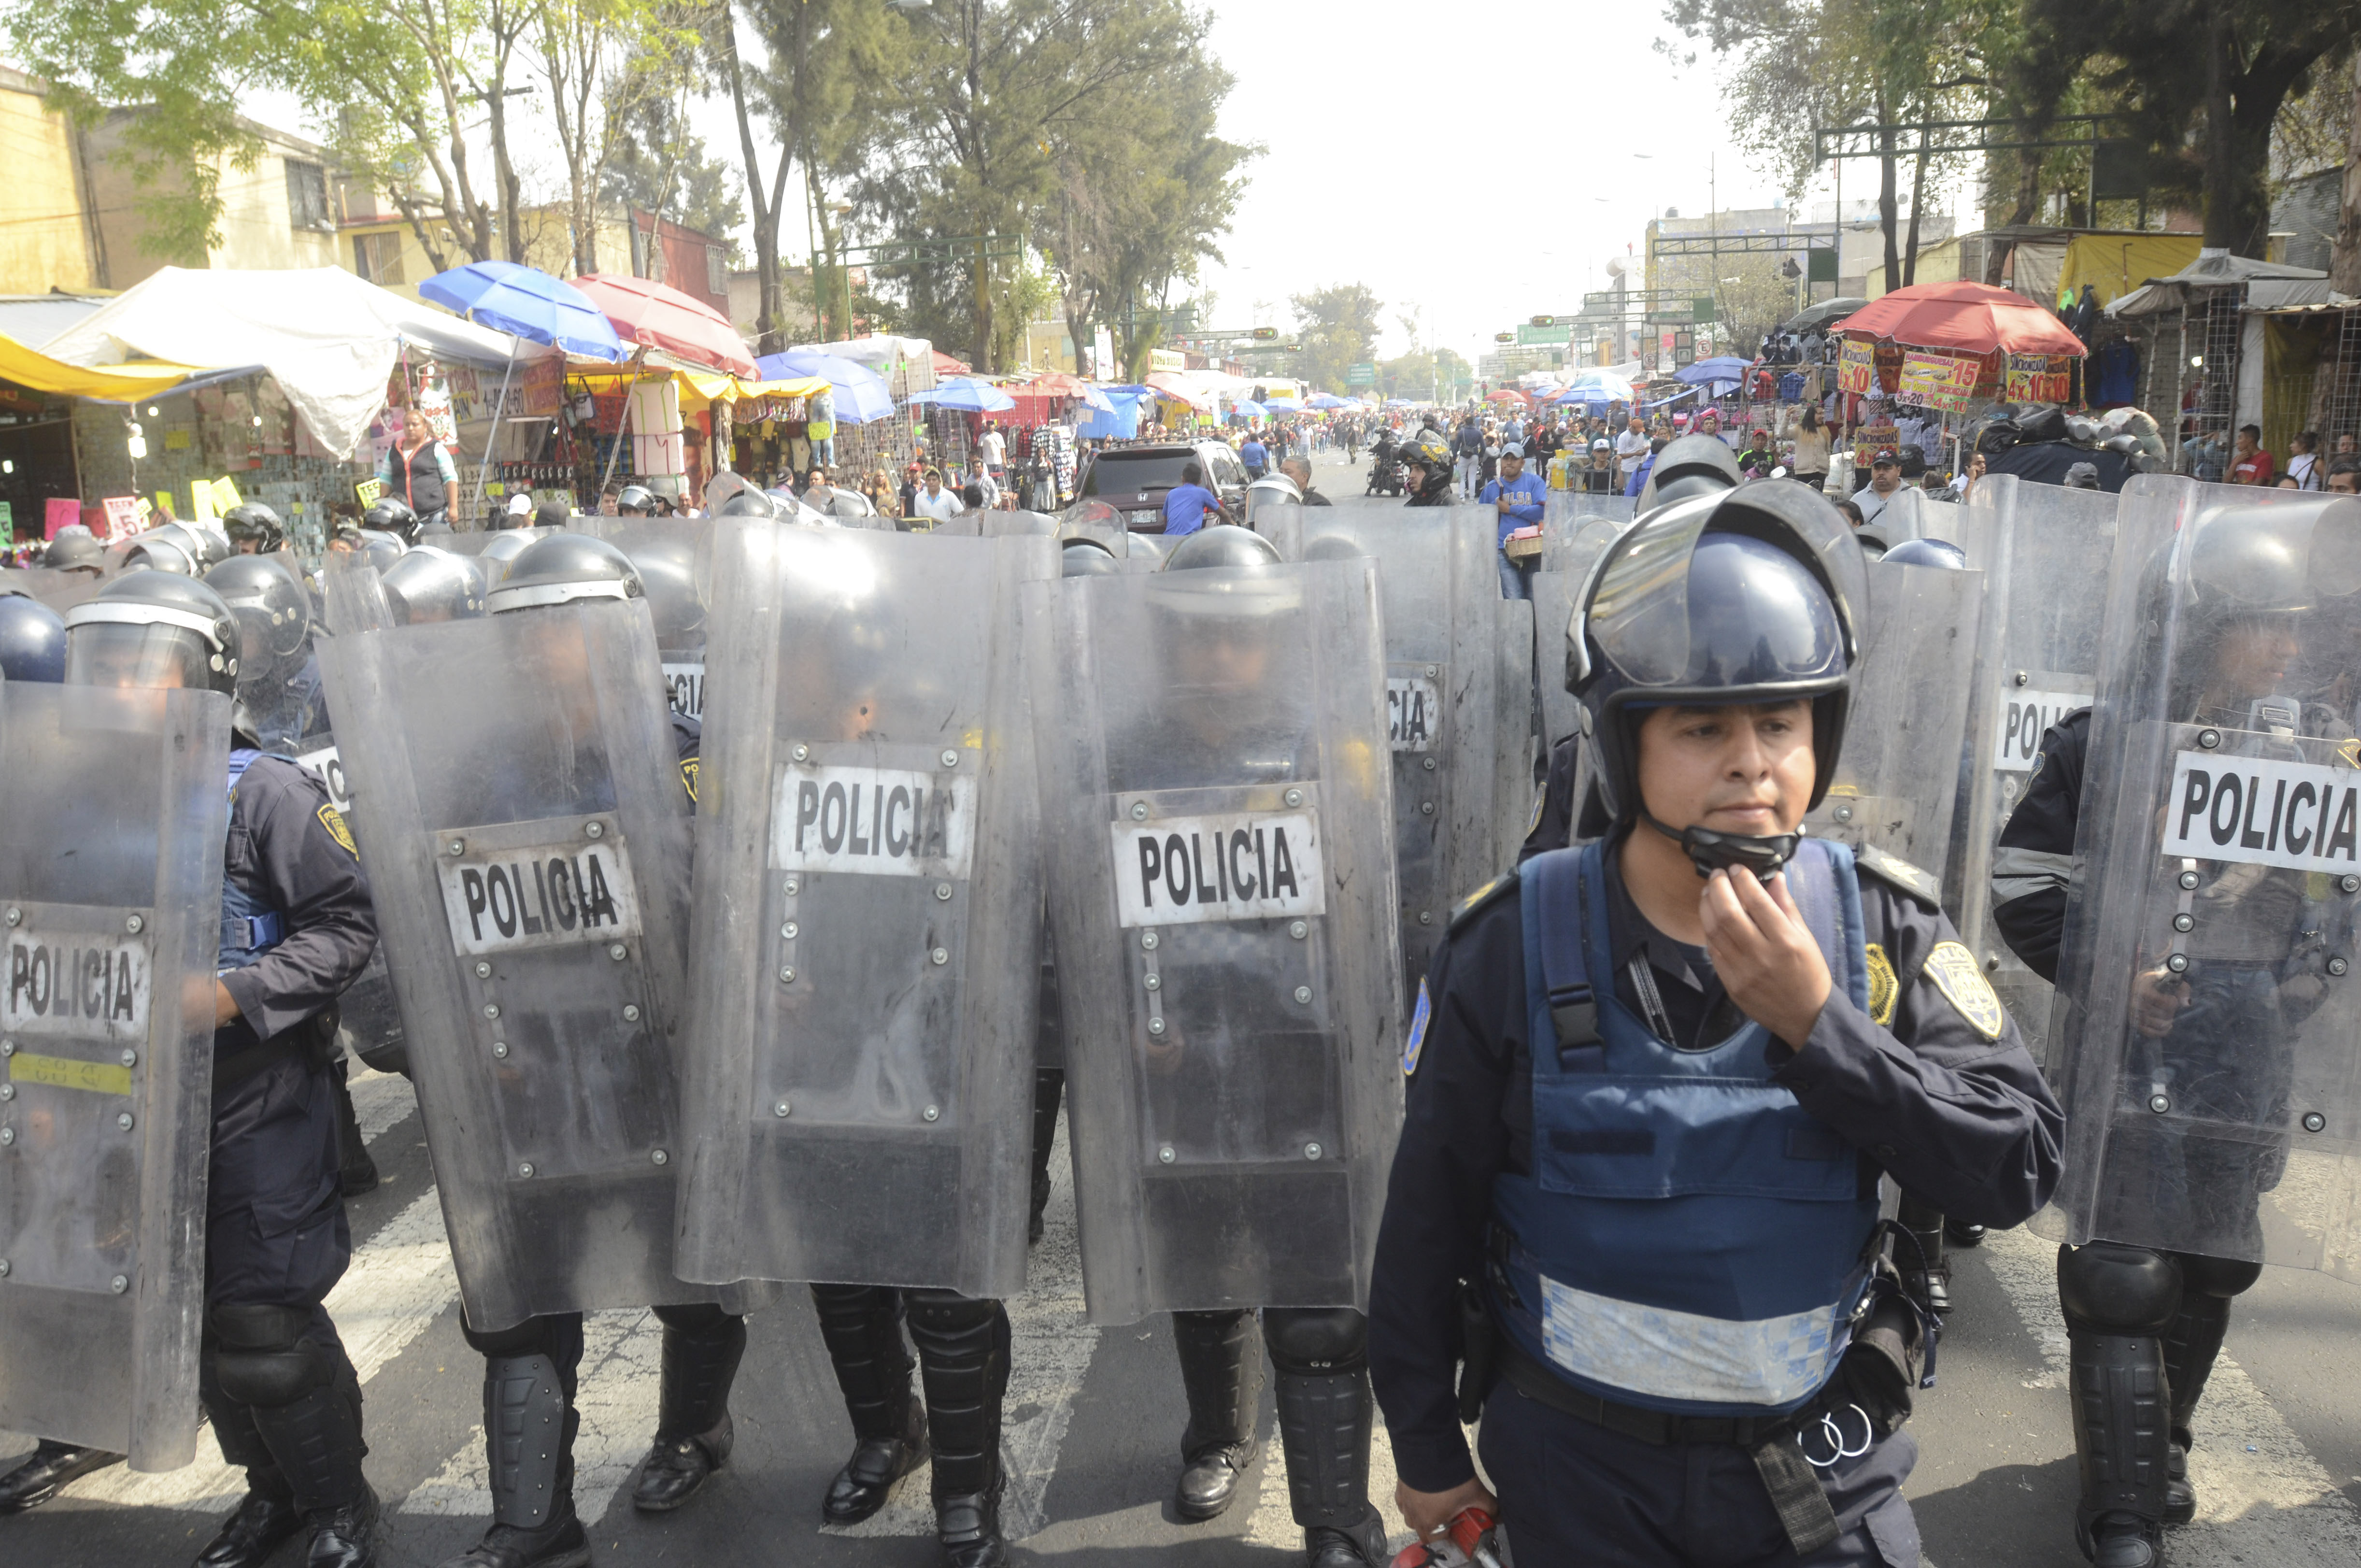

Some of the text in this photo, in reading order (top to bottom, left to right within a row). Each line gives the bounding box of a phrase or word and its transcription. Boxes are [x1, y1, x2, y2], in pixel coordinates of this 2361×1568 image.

[1152, 355, 1166, 365] VIDEO
[795, 780, 947, 859] POLICIA
[2179, 769, 2358, 862] POLICIA
[461, 854, 619, 941] POLICIA
[1138, 827, 1299, 908] POLICIA
[11, 944, 134, 1021] POLICIA
